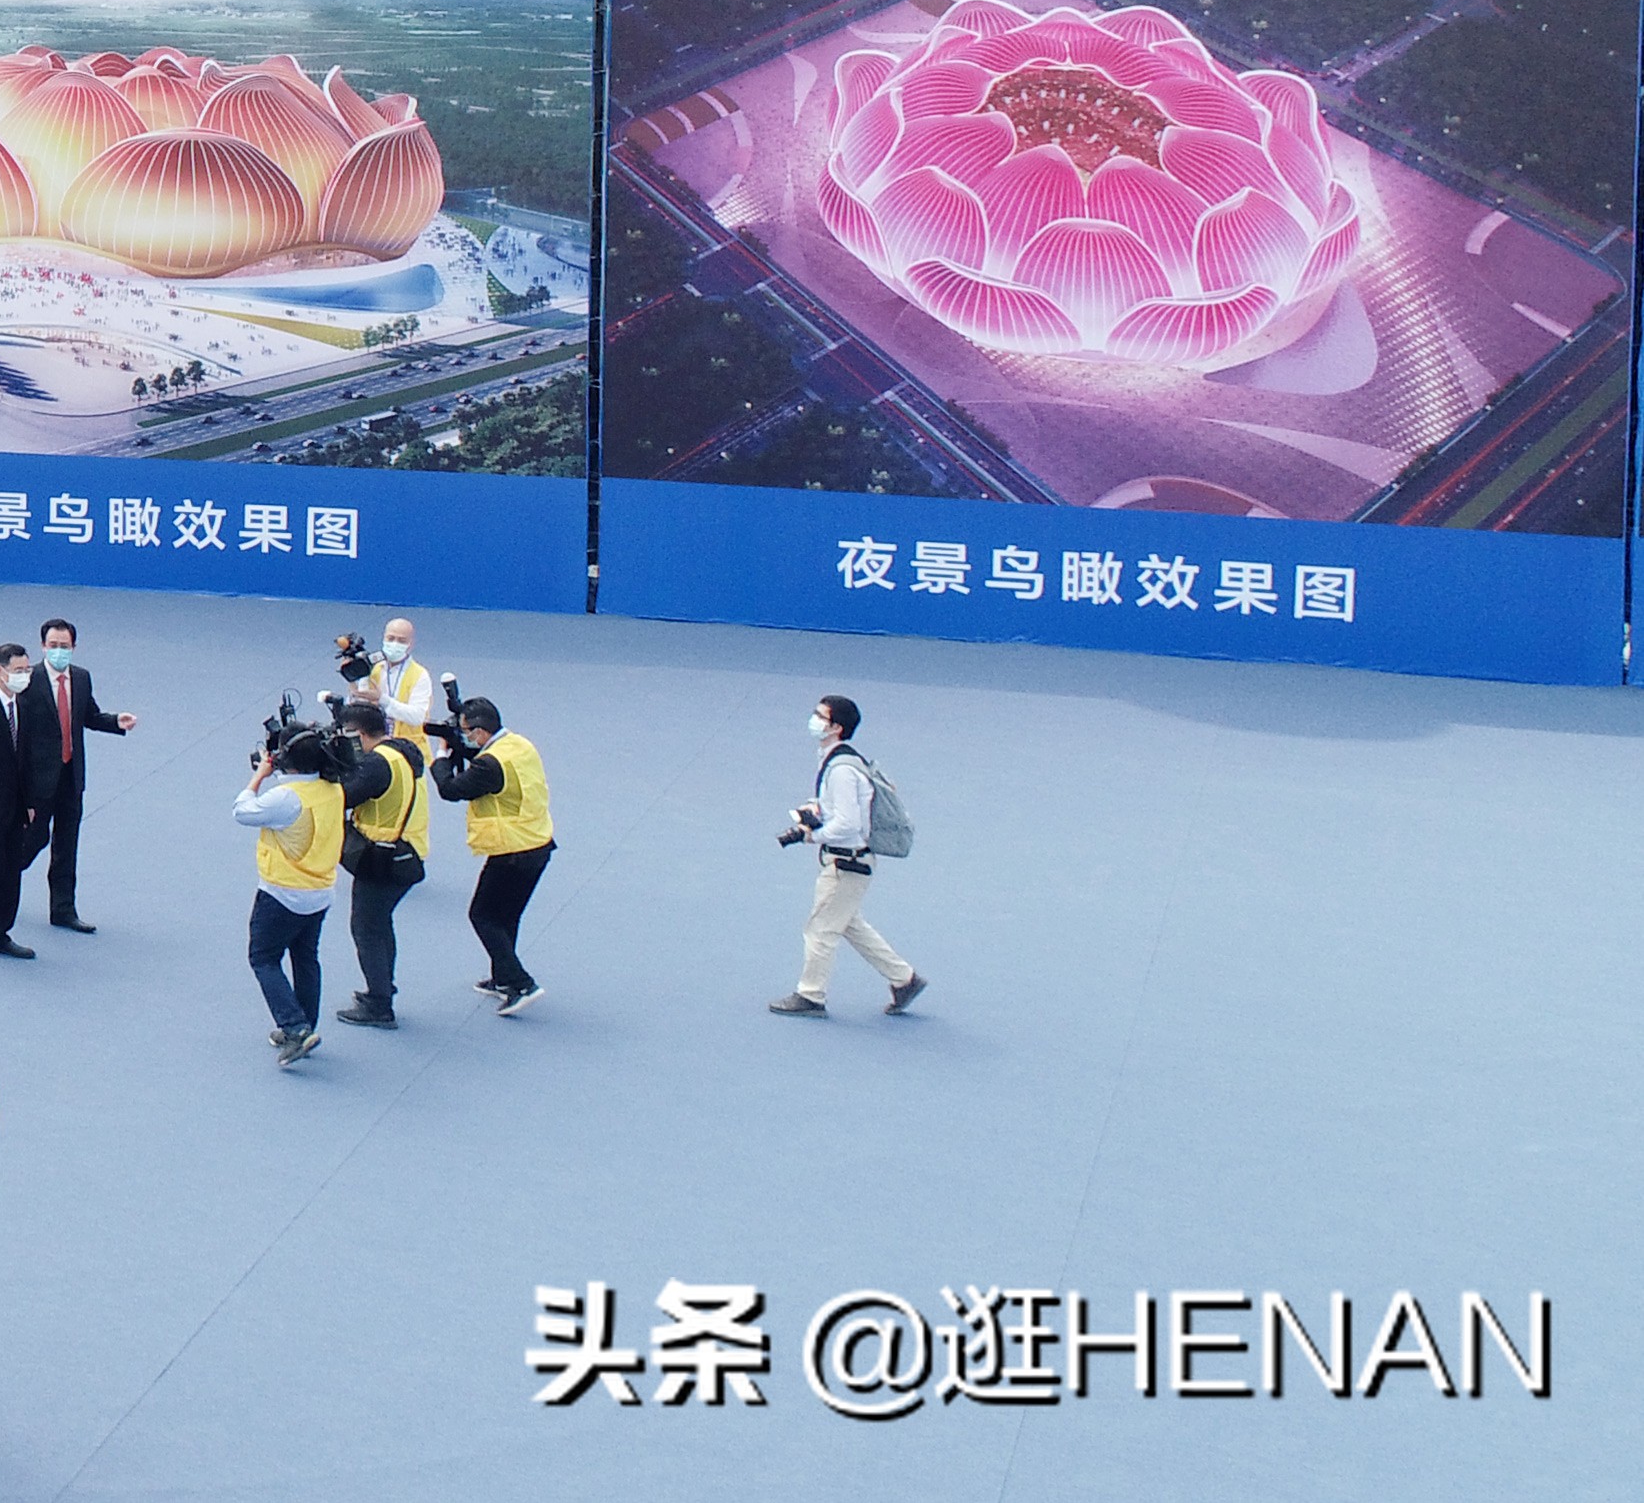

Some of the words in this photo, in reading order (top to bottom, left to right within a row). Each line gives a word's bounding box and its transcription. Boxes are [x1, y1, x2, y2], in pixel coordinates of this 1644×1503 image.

[837, 536, 1356, 622] 夜景鸟瞰效果图
